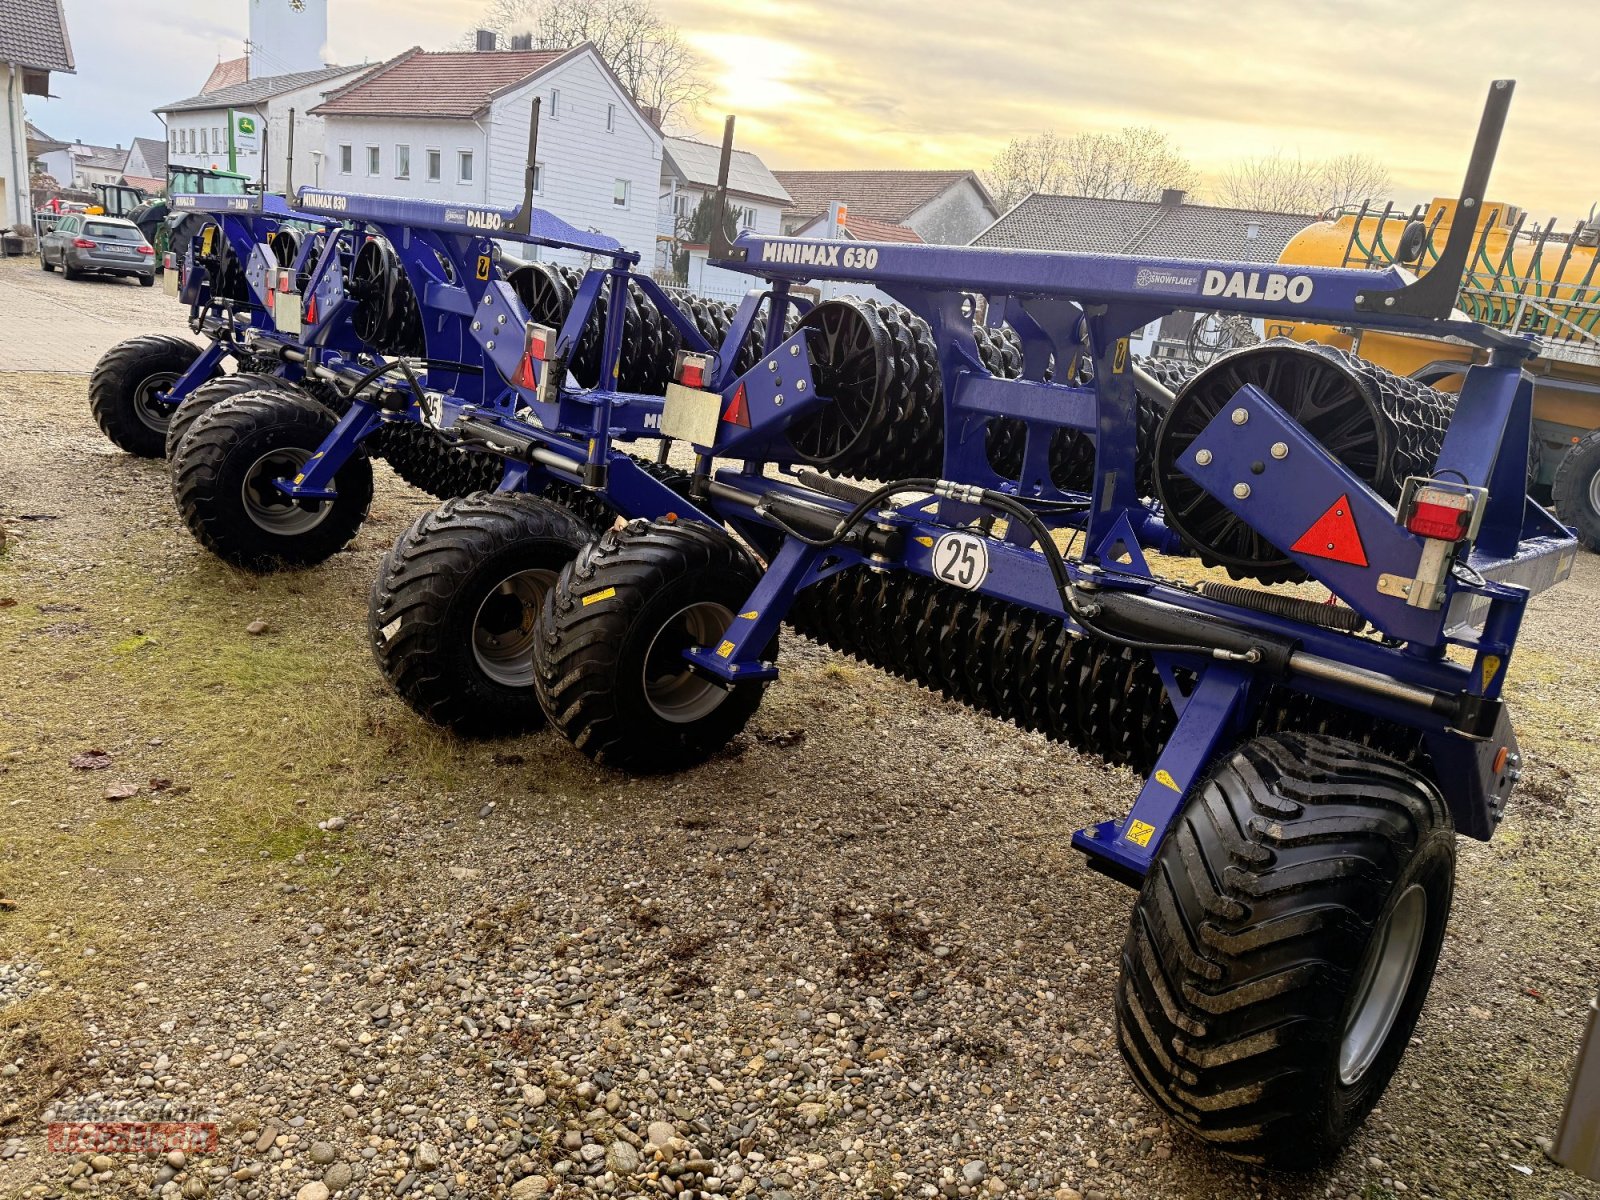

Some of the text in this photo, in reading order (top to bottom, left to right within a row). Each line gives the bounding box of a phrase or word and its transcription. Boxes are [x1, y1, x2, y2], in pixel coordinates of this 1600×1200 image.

[467, 210, 501, 231] DALBO
[762, 242, 878, 270] MINIMAX 630
[1202, 269, 1314, 304] DALBO
[941, 539, 978, 584] 25
